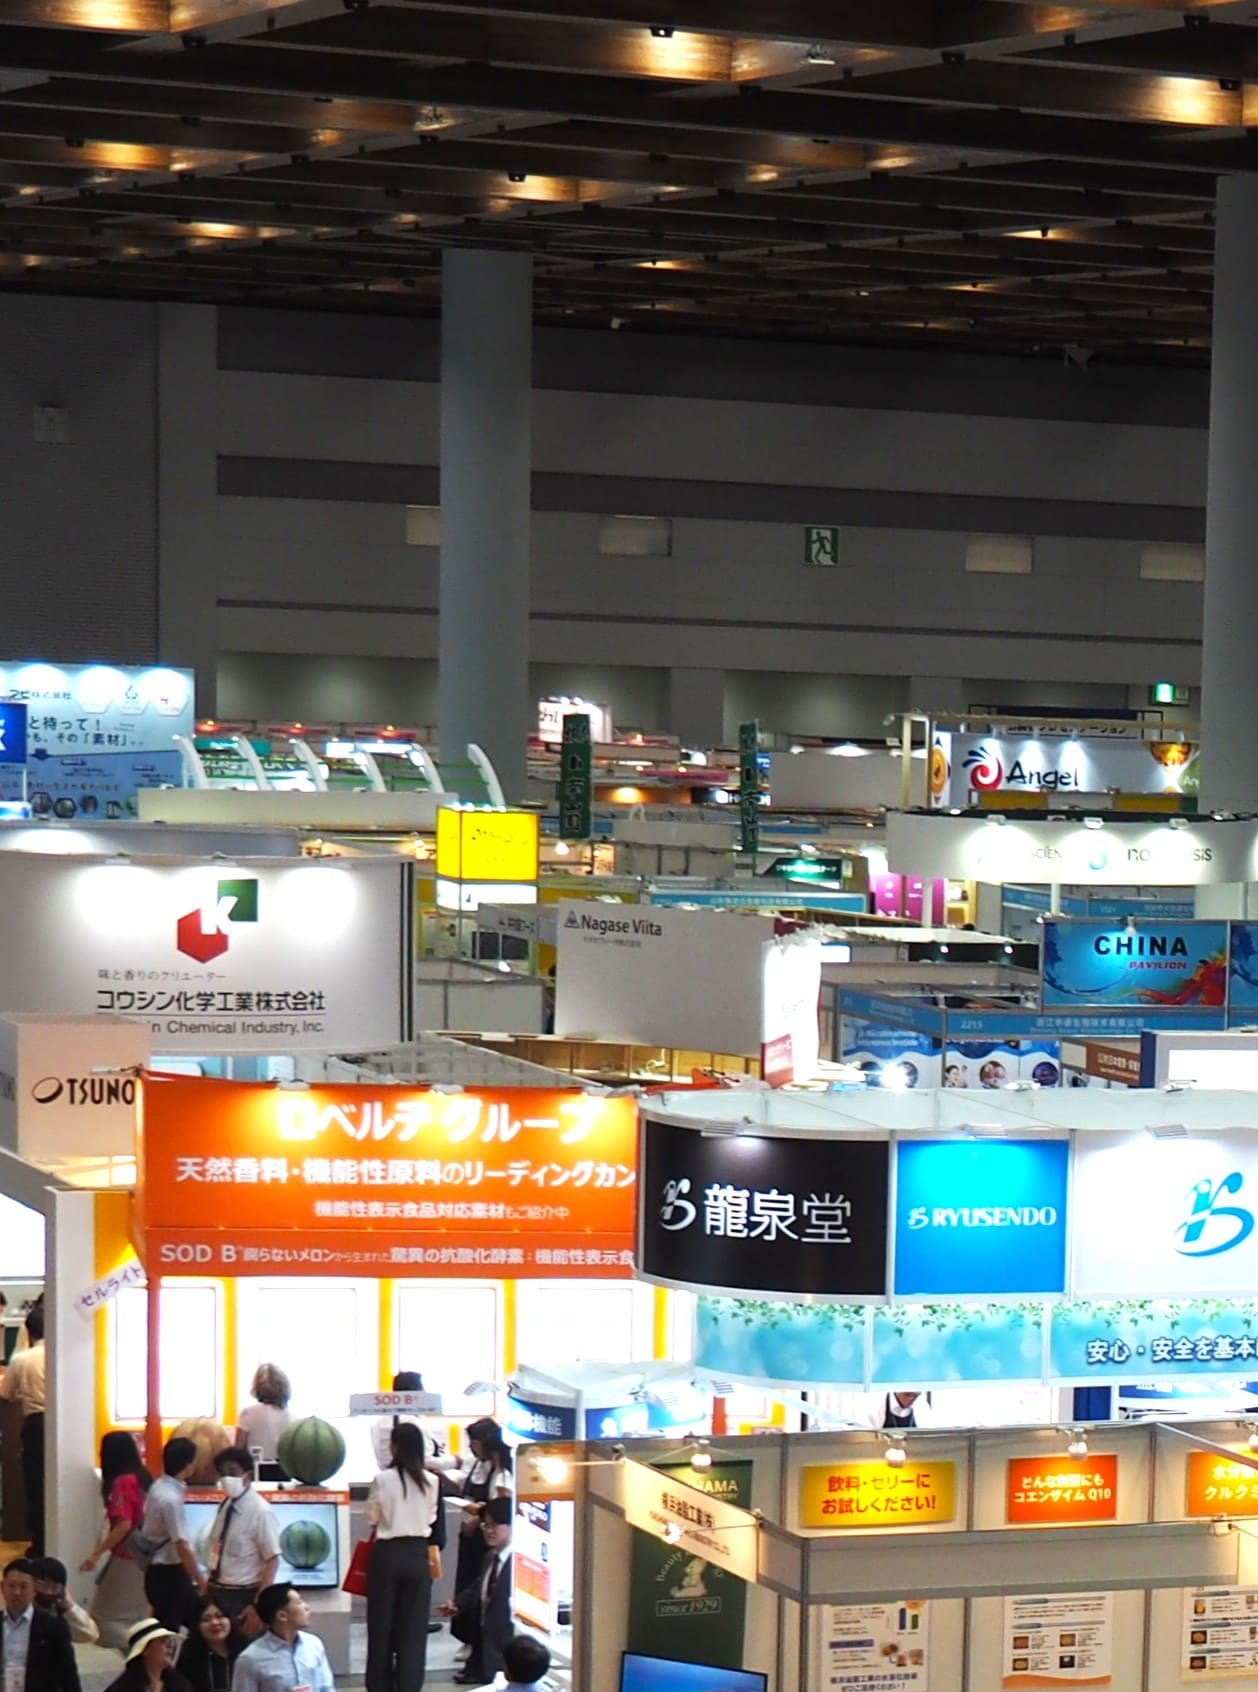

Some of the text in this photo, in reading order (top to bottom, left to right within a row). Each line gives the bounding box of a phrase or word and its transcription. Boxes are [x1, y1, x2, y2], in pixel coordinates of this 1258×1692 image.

[1005, 760, 1079, 790] Angel
[581, 914, 662, 936] Nagase Viita
[1094, 935, 1189, 957] CHINA
[1129, 961, 1188, 969] PAVILION
[96, 989, 326, 1012] コウシン化学工業株式会社
[166, 1019, 237, 1035] Chemical
[302, 1020, 326, 1033] Inc.
[66, 1076, 136, 1106] TSUNO
[703, 1182, 853, 1245] 龍泉堂
[931, 1205, 1058, 1229] RYUSENDO
[160, 1243, 213, 1264] SOD
[220, 1244, 237, 1263] B
[374, 1394, 400, 1406] SOD
